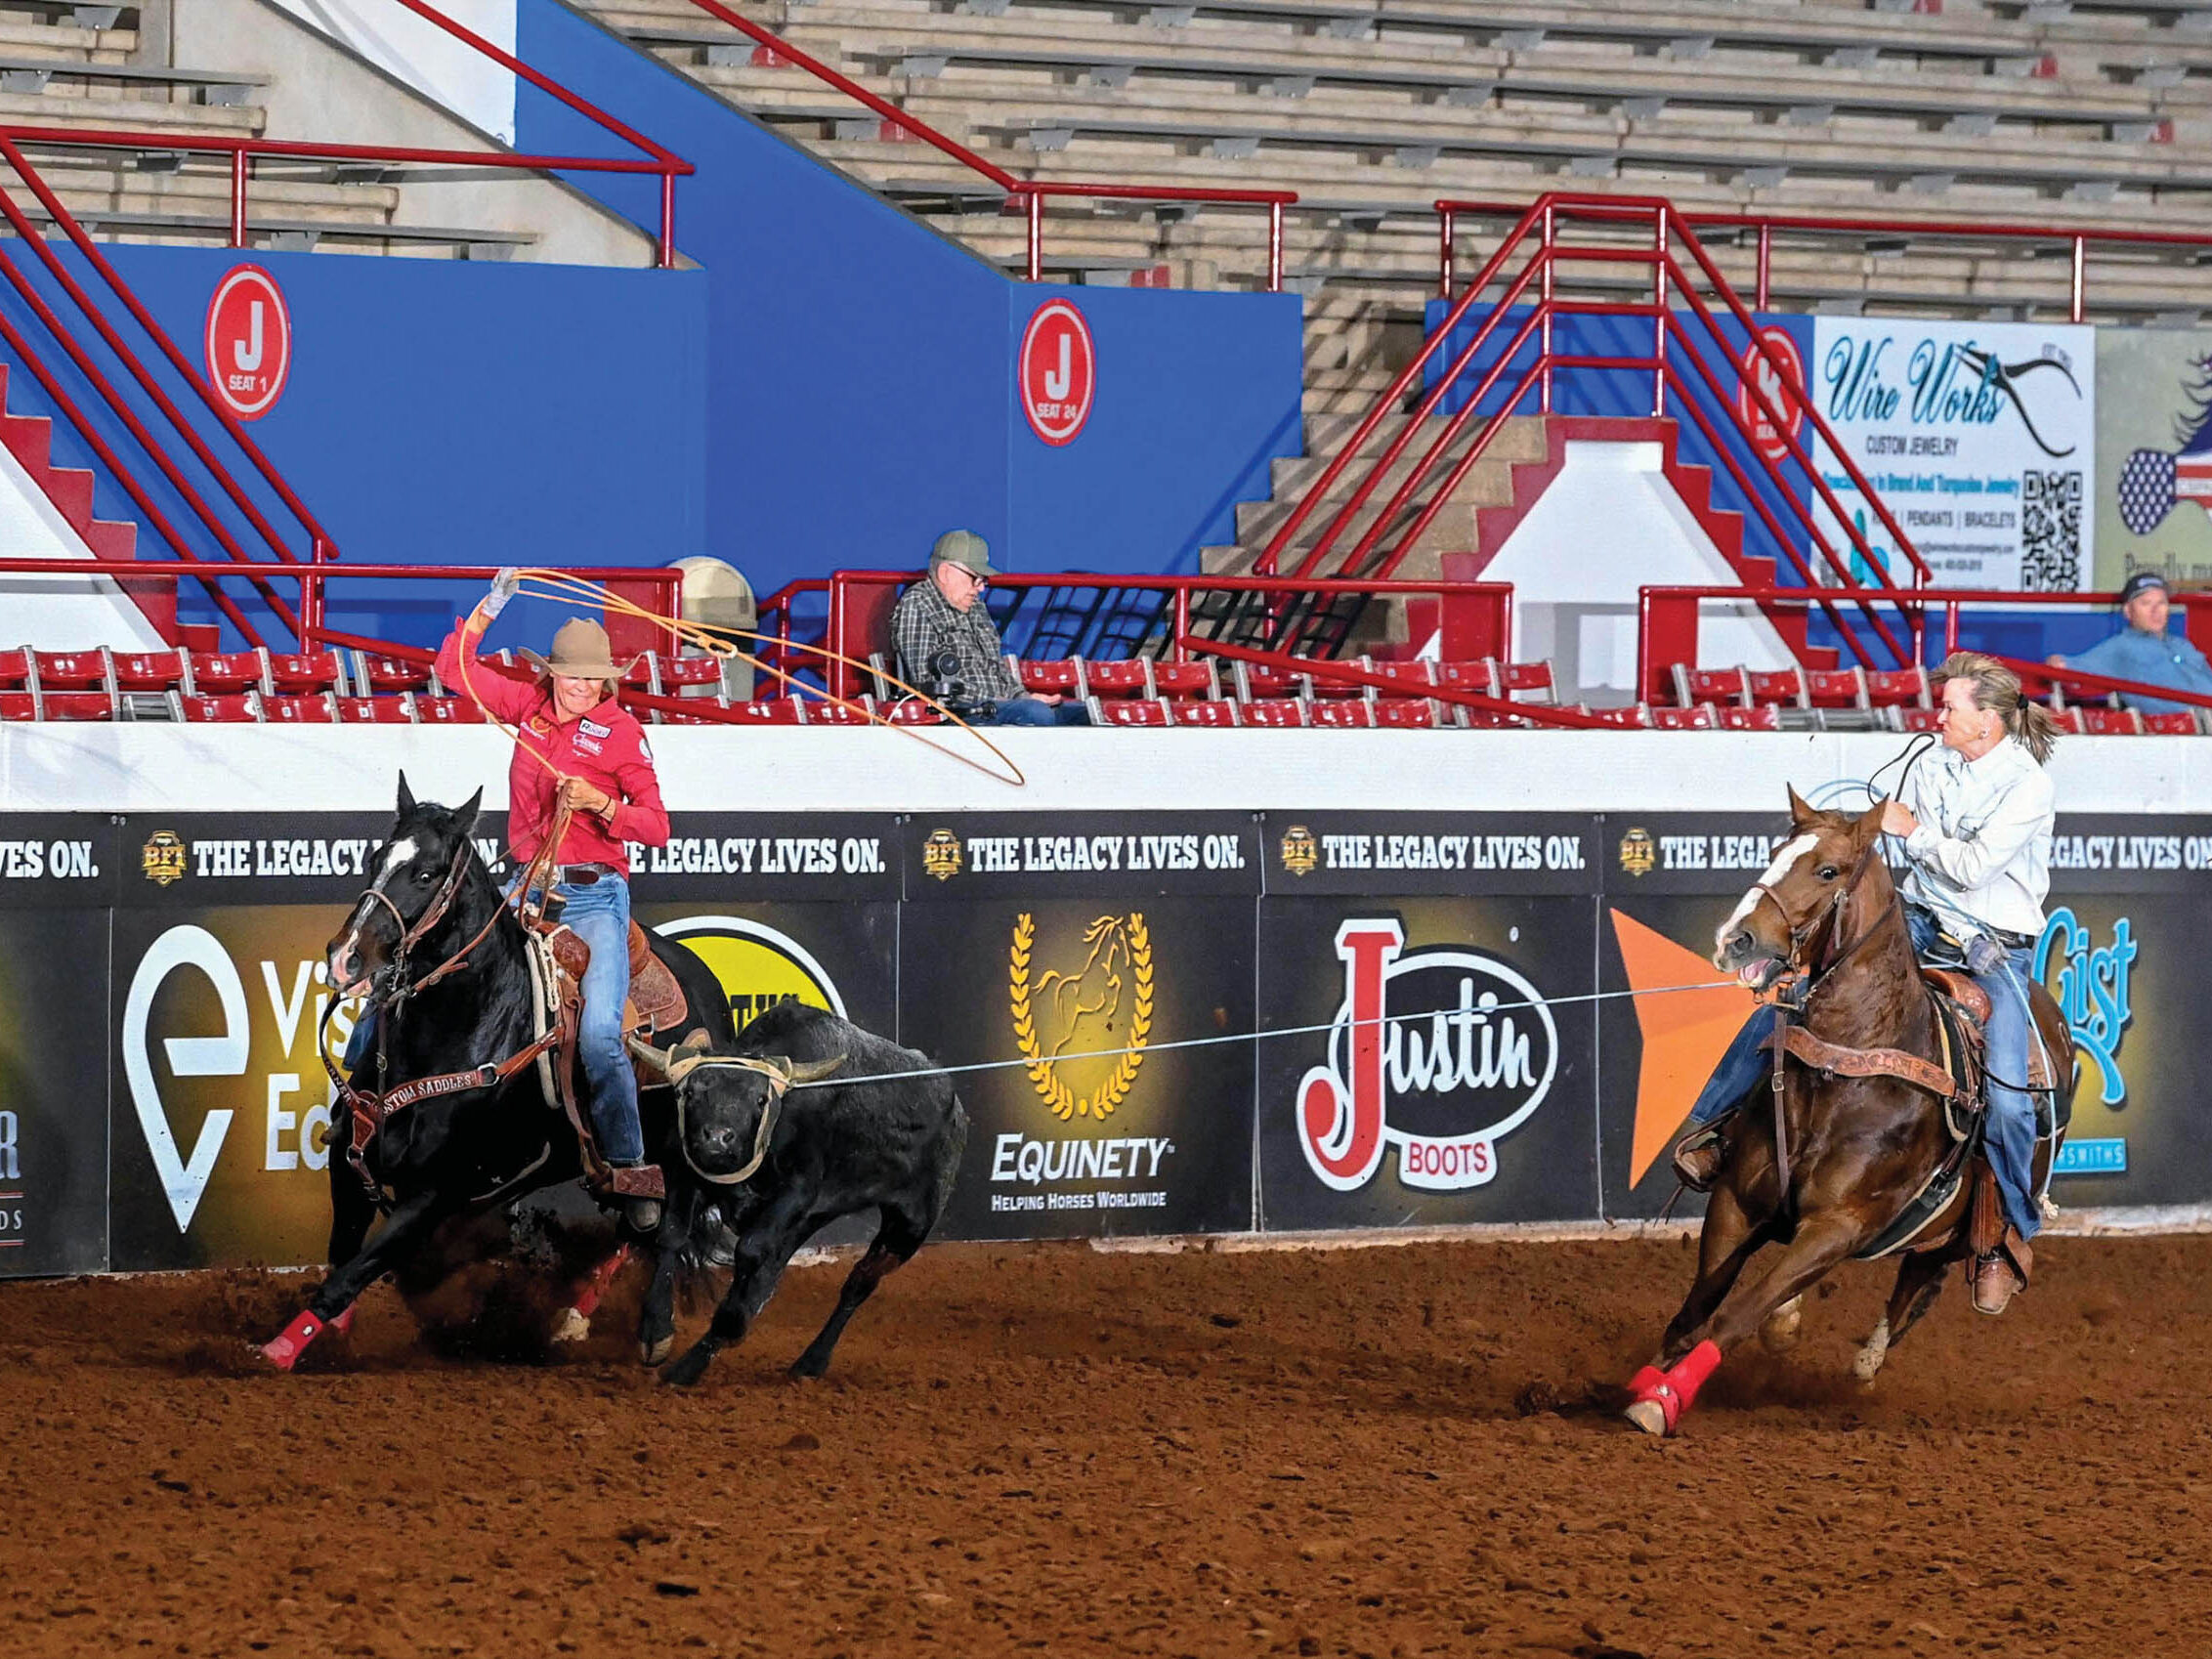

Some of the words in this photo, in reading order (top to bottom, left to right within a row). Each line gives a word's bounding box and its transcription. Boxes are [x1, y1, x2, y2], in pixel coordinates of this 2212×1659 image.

[234, 300, 264, 371] J
[229, 374, 256, 391] SEAT
[260, 377, 267, 391] 1
[1044, 333, 1071, 401] J
[1825, 336, 1902, 422] Wire
[1908, 338, 2006, 424] Works
[1038, 403, 1061, 418] SEAT
[1866, 435, 1905, 454] CUSTOM
[1909, 437, 1959, 456] JEWELRY
[1965, 511, 2016, 530] BRACELETS
[50, 840, 100, 878] ON.
[192, 840, 250, 876] THE
[256, 839, 368, 875] LEGACY
[651, 838, 756, 873] LEGACY
[760, 838, 837, 873] LIVES
[841, 838, 885, 873] ON.
[967, 837, 1019, 872] THE
[1023, 836, 1124, 872] LEGACY
[1127, 835, 1199, 871] LIVES
[1203, 835, 1246, 870] ON.
[1322, 835, 1372, 869] THE
[1375, 835, 1469, 870] LEGACY
[1472, 835, 1542, 870] LIVES
[1545, 835, 1586, 870] ON.
[1660, 835, 1708, 869] THE
[1710, 835, 1789, 869] LEGA
[2116, 835, 2182, 870] LIVES
[2032, 907, 2138, 1104] Gist
[1296, 918, 1537, 1191] Justin
[418, 1074, 472, 1096] SADDLES
[991, 1131, 1171, 1186] EQUINETY
[1409, 1141, 1488, 1174] BOOTS
[991, 1194, 1044, 1212] HELPING
[1047, 1192, 1094, 1210] HORSES
[1096, 1191, 1168, 1208] WORLDWIDE
